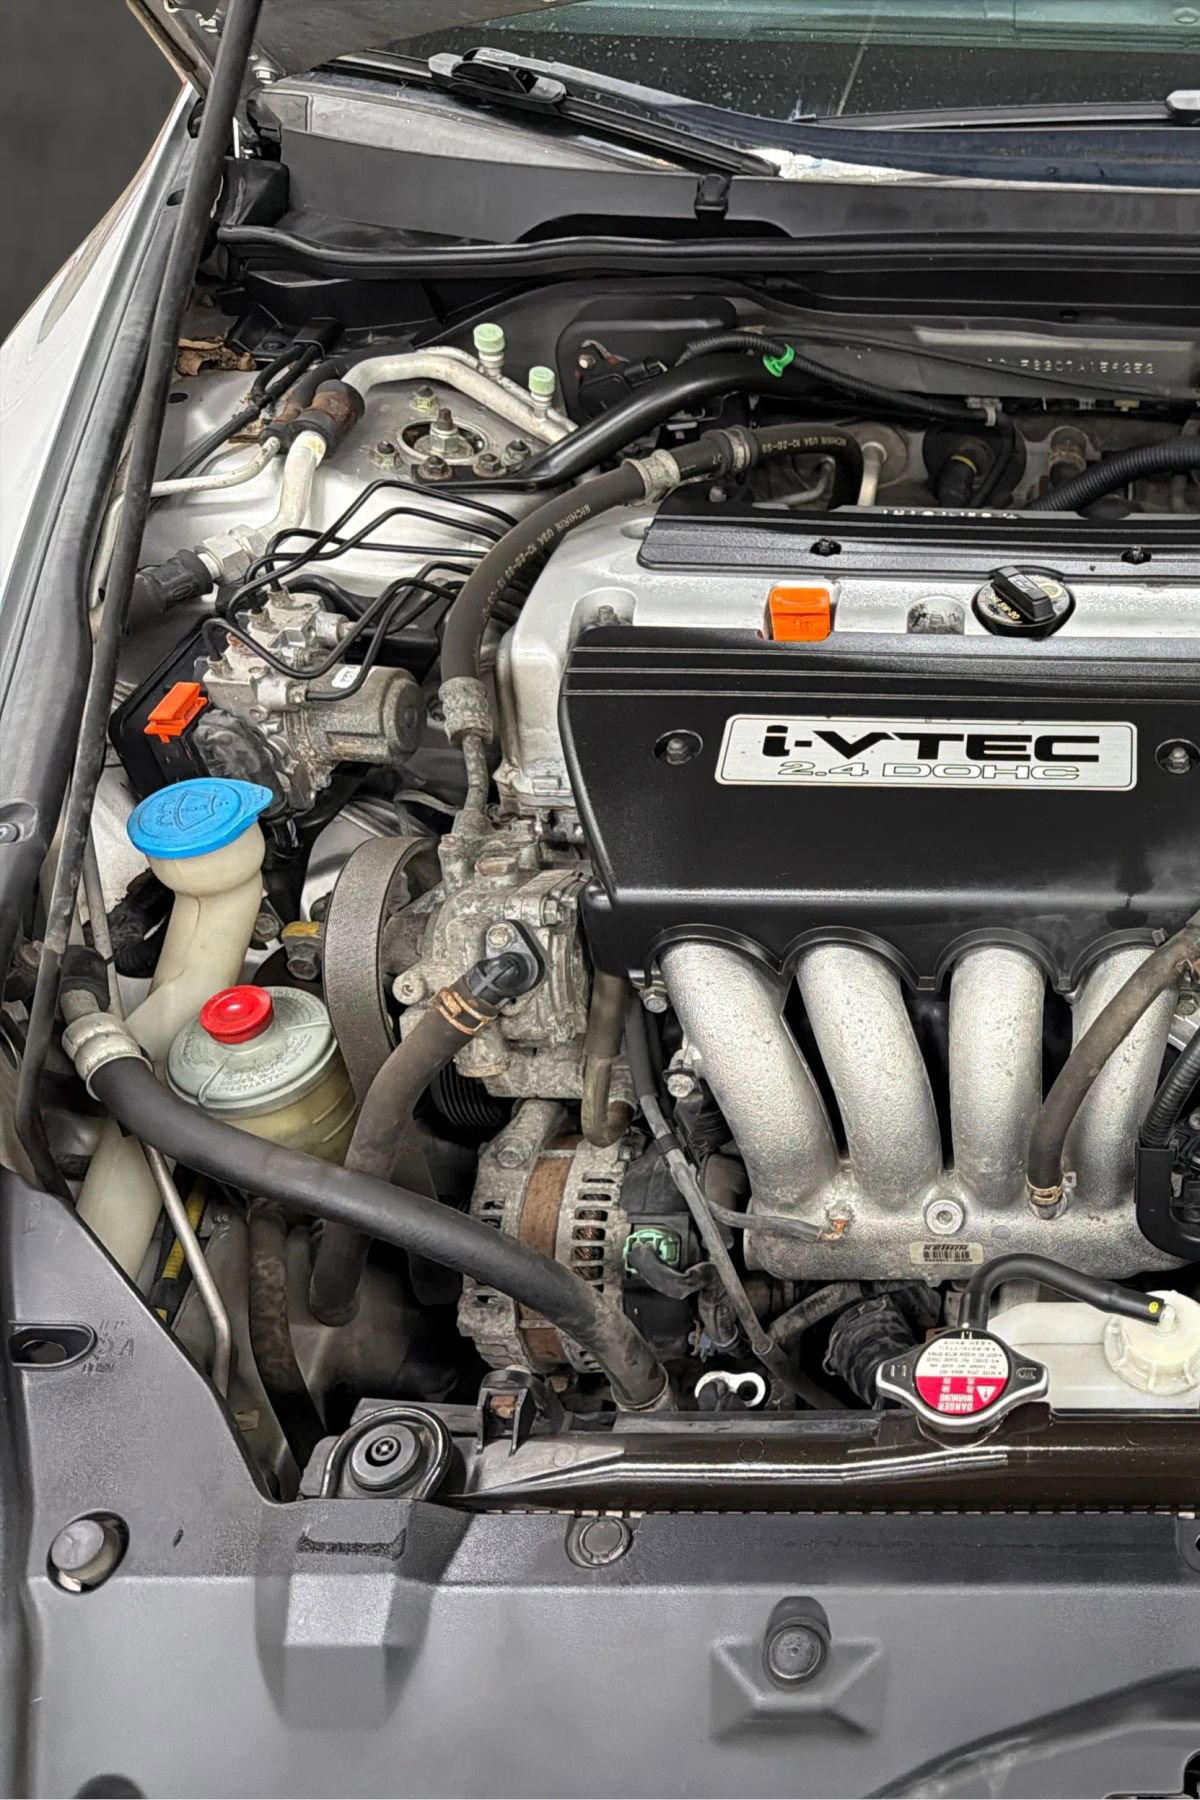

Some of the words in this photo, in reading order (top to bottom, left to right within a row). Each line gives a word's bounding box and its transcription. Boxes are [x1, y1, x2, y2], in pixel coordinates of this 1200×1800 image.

[761, 725, 1101, 763] i-VTEC
[778, 761, 869, 777] 2.4
[882, 762, 1080, 780] DOHC
[937, 1401, 973, 1412] DANGER
